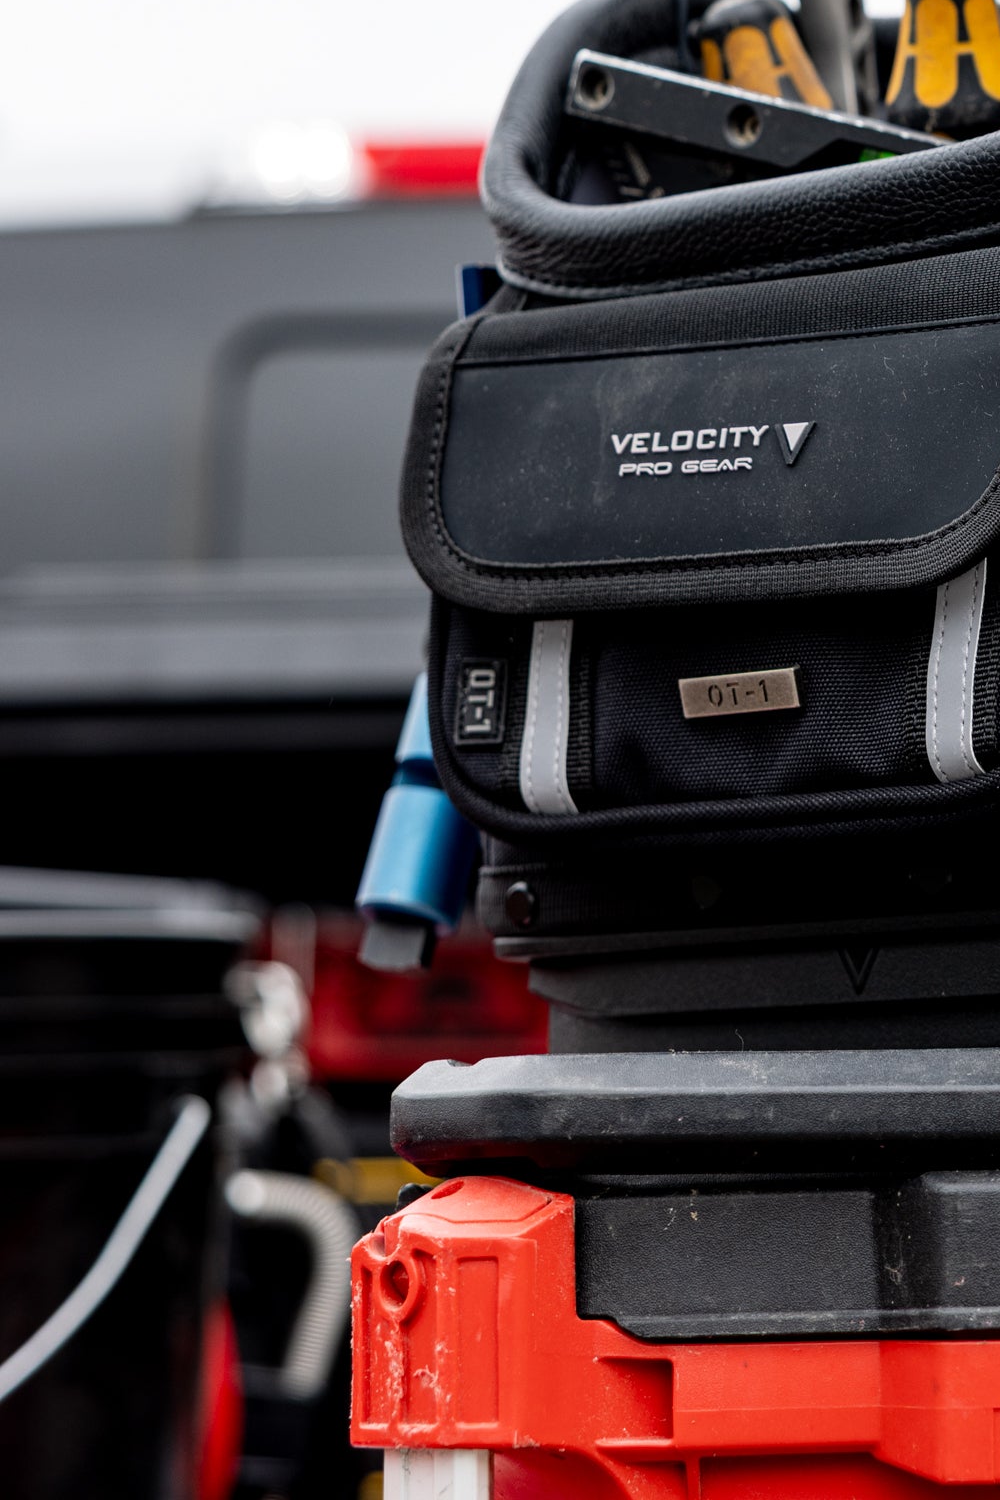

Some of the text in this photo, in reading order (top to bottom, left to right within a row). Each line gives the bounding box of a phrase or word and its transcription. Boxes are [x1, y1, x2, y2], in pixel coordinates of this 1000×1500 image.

[611, 425, 769, 454] VELOCITY
[618, 457, 752, 477] PRO GEAR
[464, 669, 496, 732] OT-1
[707, 679, 768, 707] OT-1
